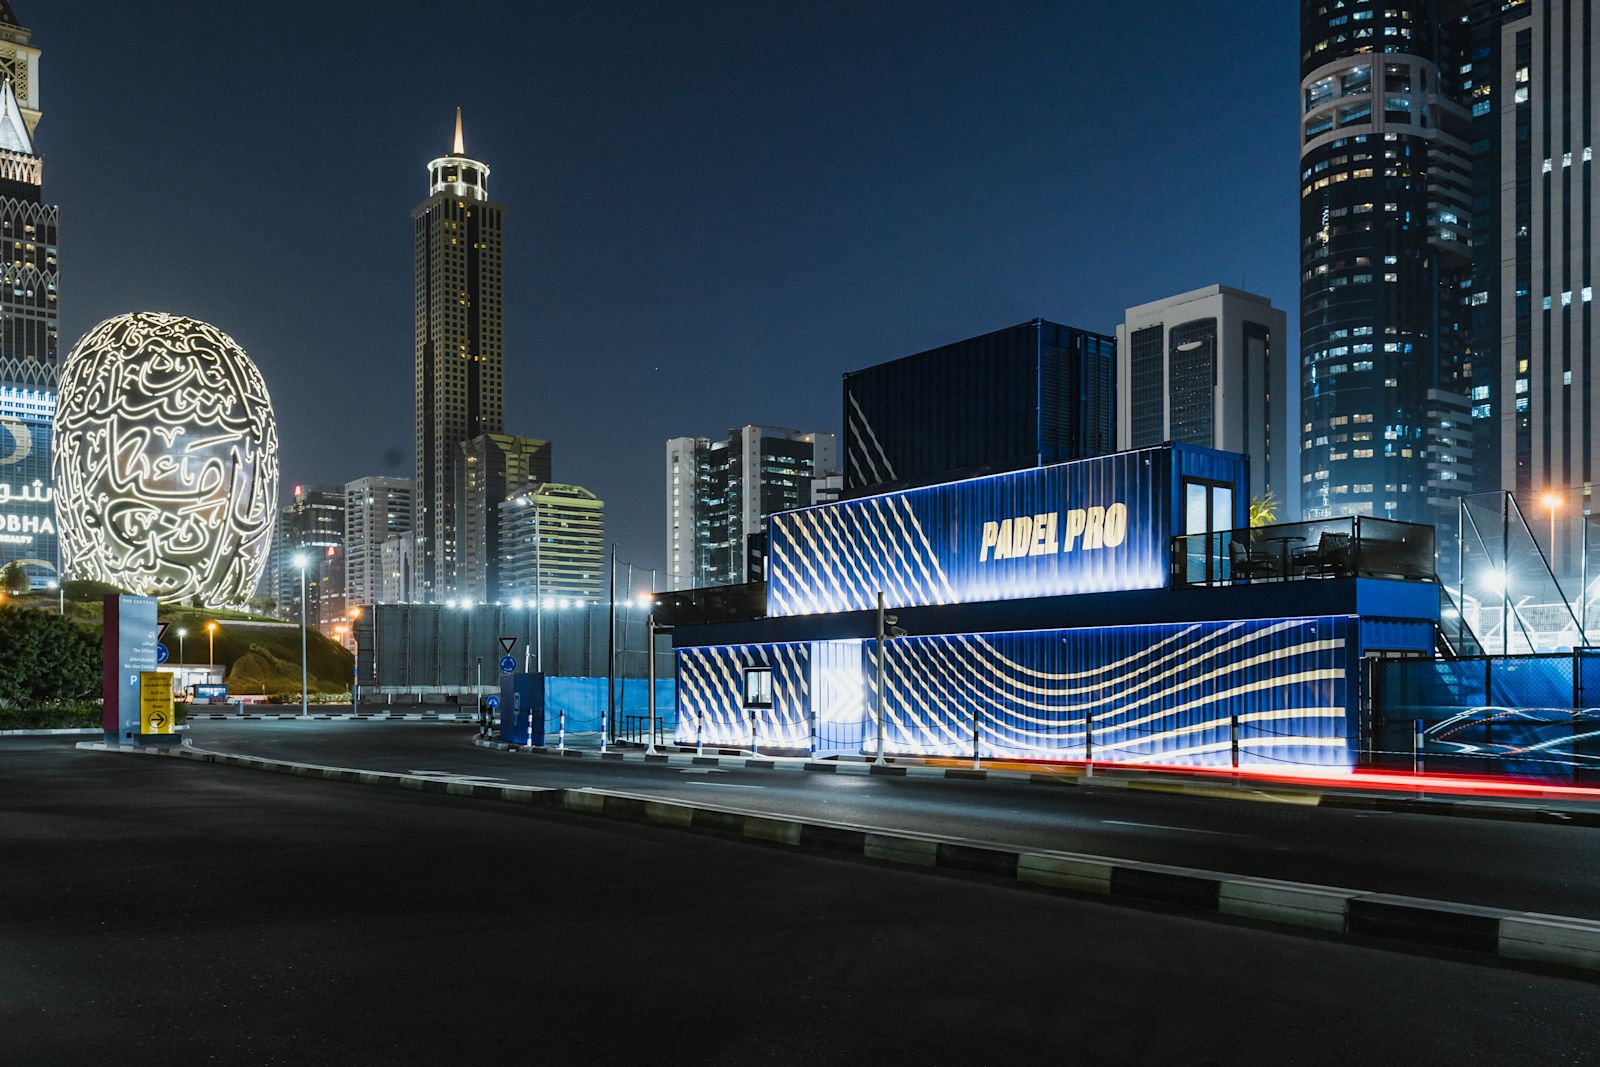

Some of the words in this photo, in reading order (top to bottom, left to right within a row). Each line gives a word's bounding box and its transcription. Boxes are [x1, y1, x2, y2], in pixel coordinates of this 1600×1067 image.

[979, 512, 1059, 563] PADEL
[1064, 502, 1127, 553] PRO
[130, 675, 138, 686] P
